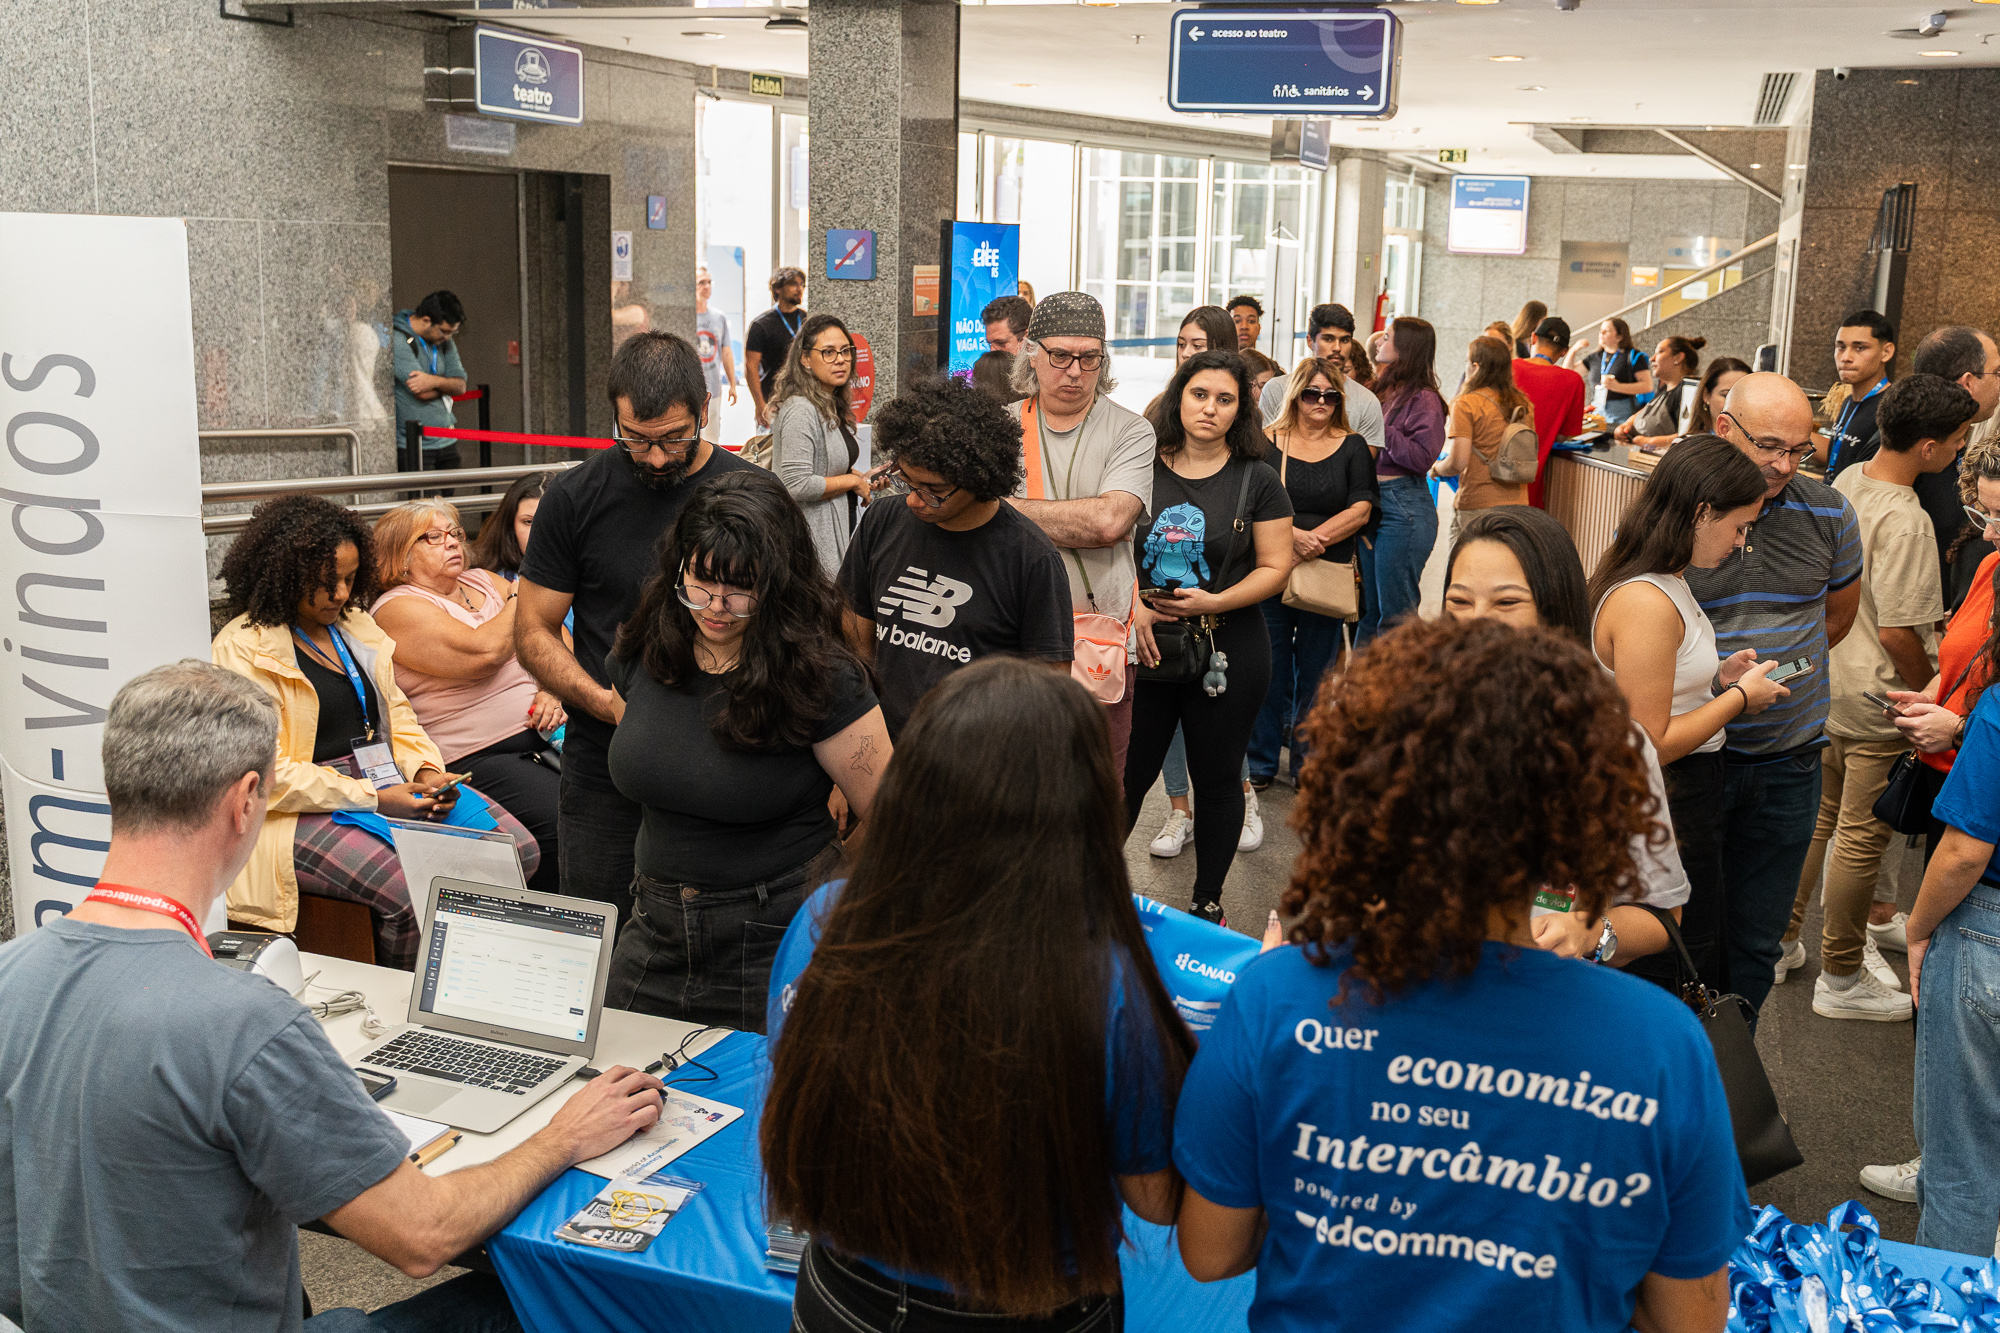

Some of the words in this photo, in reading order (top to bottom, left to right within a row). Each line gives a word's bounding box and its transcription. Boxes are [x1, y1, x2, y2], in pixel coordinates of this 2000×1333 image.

[1211, 29, 1243, 38] acesso
[1244, 29, 1257, 38] ao
[1258, 28, 1288, 38] teatro
[512, 83, 553, 106] teatro
[752, 76, 781, 96] SAÍDA
[1303, 85, 1349, 97] sanitários
[955, 318, 974, 335] NÃO
[956, 337, 978, 352] VAGA
[889, 624, 971, 663] balance
[1535, 895, 1548, 904] de
[1294, 1018, 1379, 1054] Quer
[1370, 1100, 1410, 1123] no
[1418, 1104, 1470, 1130] seu
[1292, 1121, 1651, 1208] Intercâmbio?
[1294, 1177, 1380, 1211] powered
[1389, 1195, 1418, 1220] by
[600, 1229, 645, 1244] EXPO
